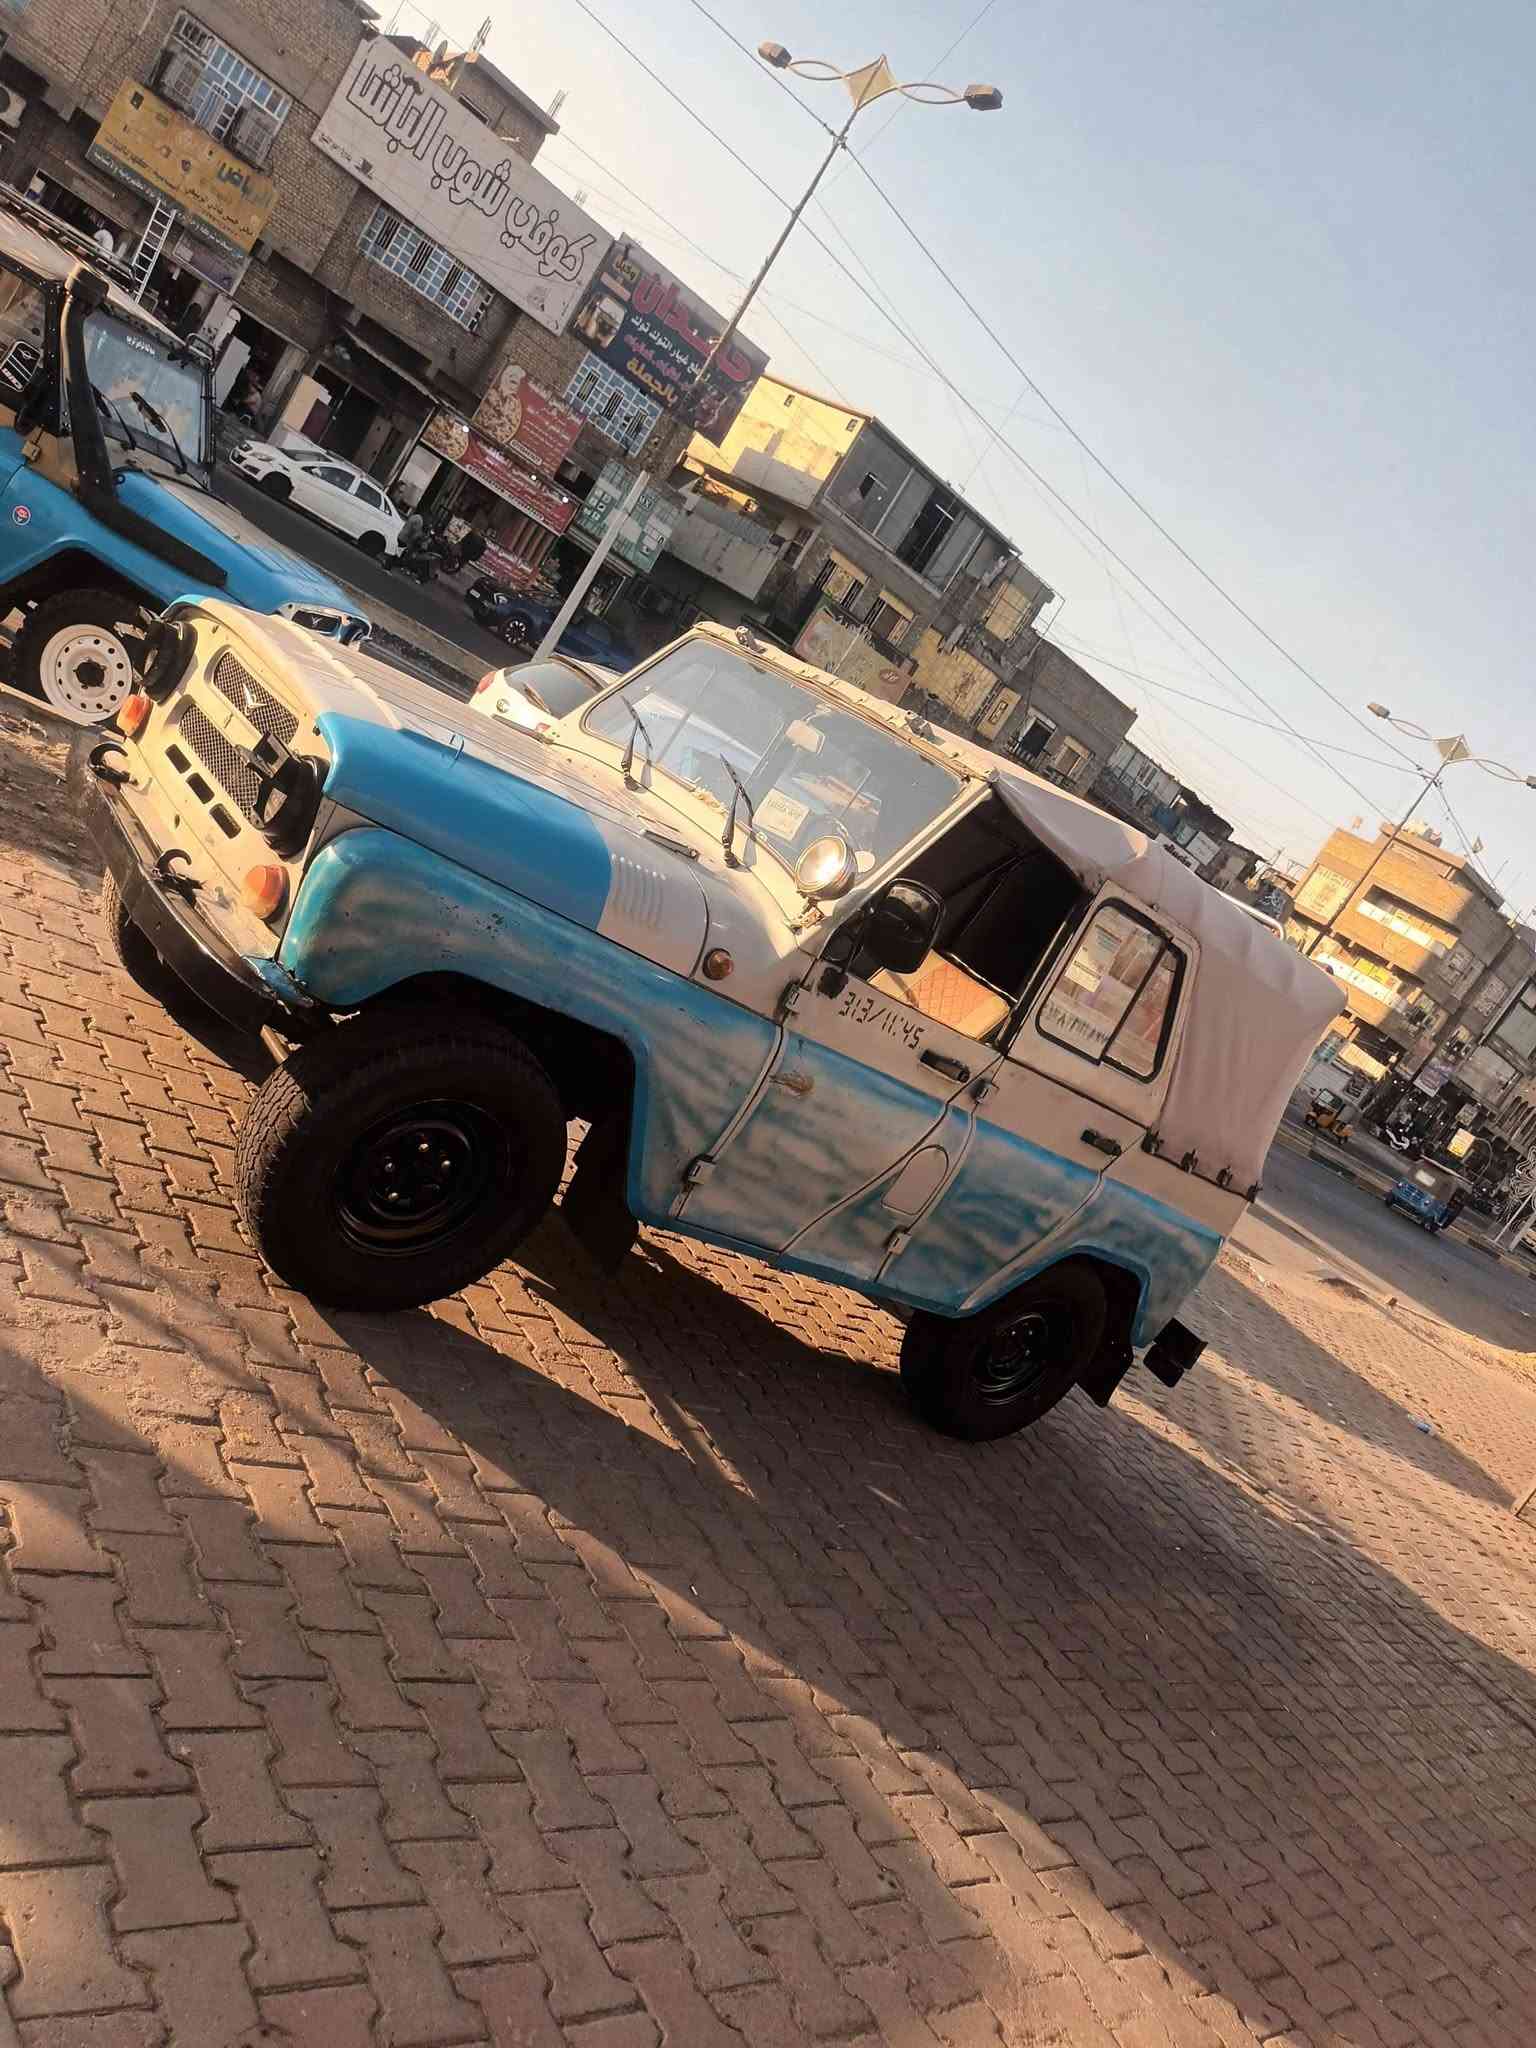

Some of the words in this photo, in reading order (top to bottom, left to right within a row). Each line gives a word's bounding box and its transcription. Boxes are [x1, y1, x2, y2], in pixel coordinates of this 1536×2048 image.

[346, 59, 447, 160] الباشا
[431, 135, 510, 217] شوب
[500, 197, 597, 281] كوفي
[626, 357, 678, 407] بالجملة
[838, 991, 925, 1050] 313/11:45
